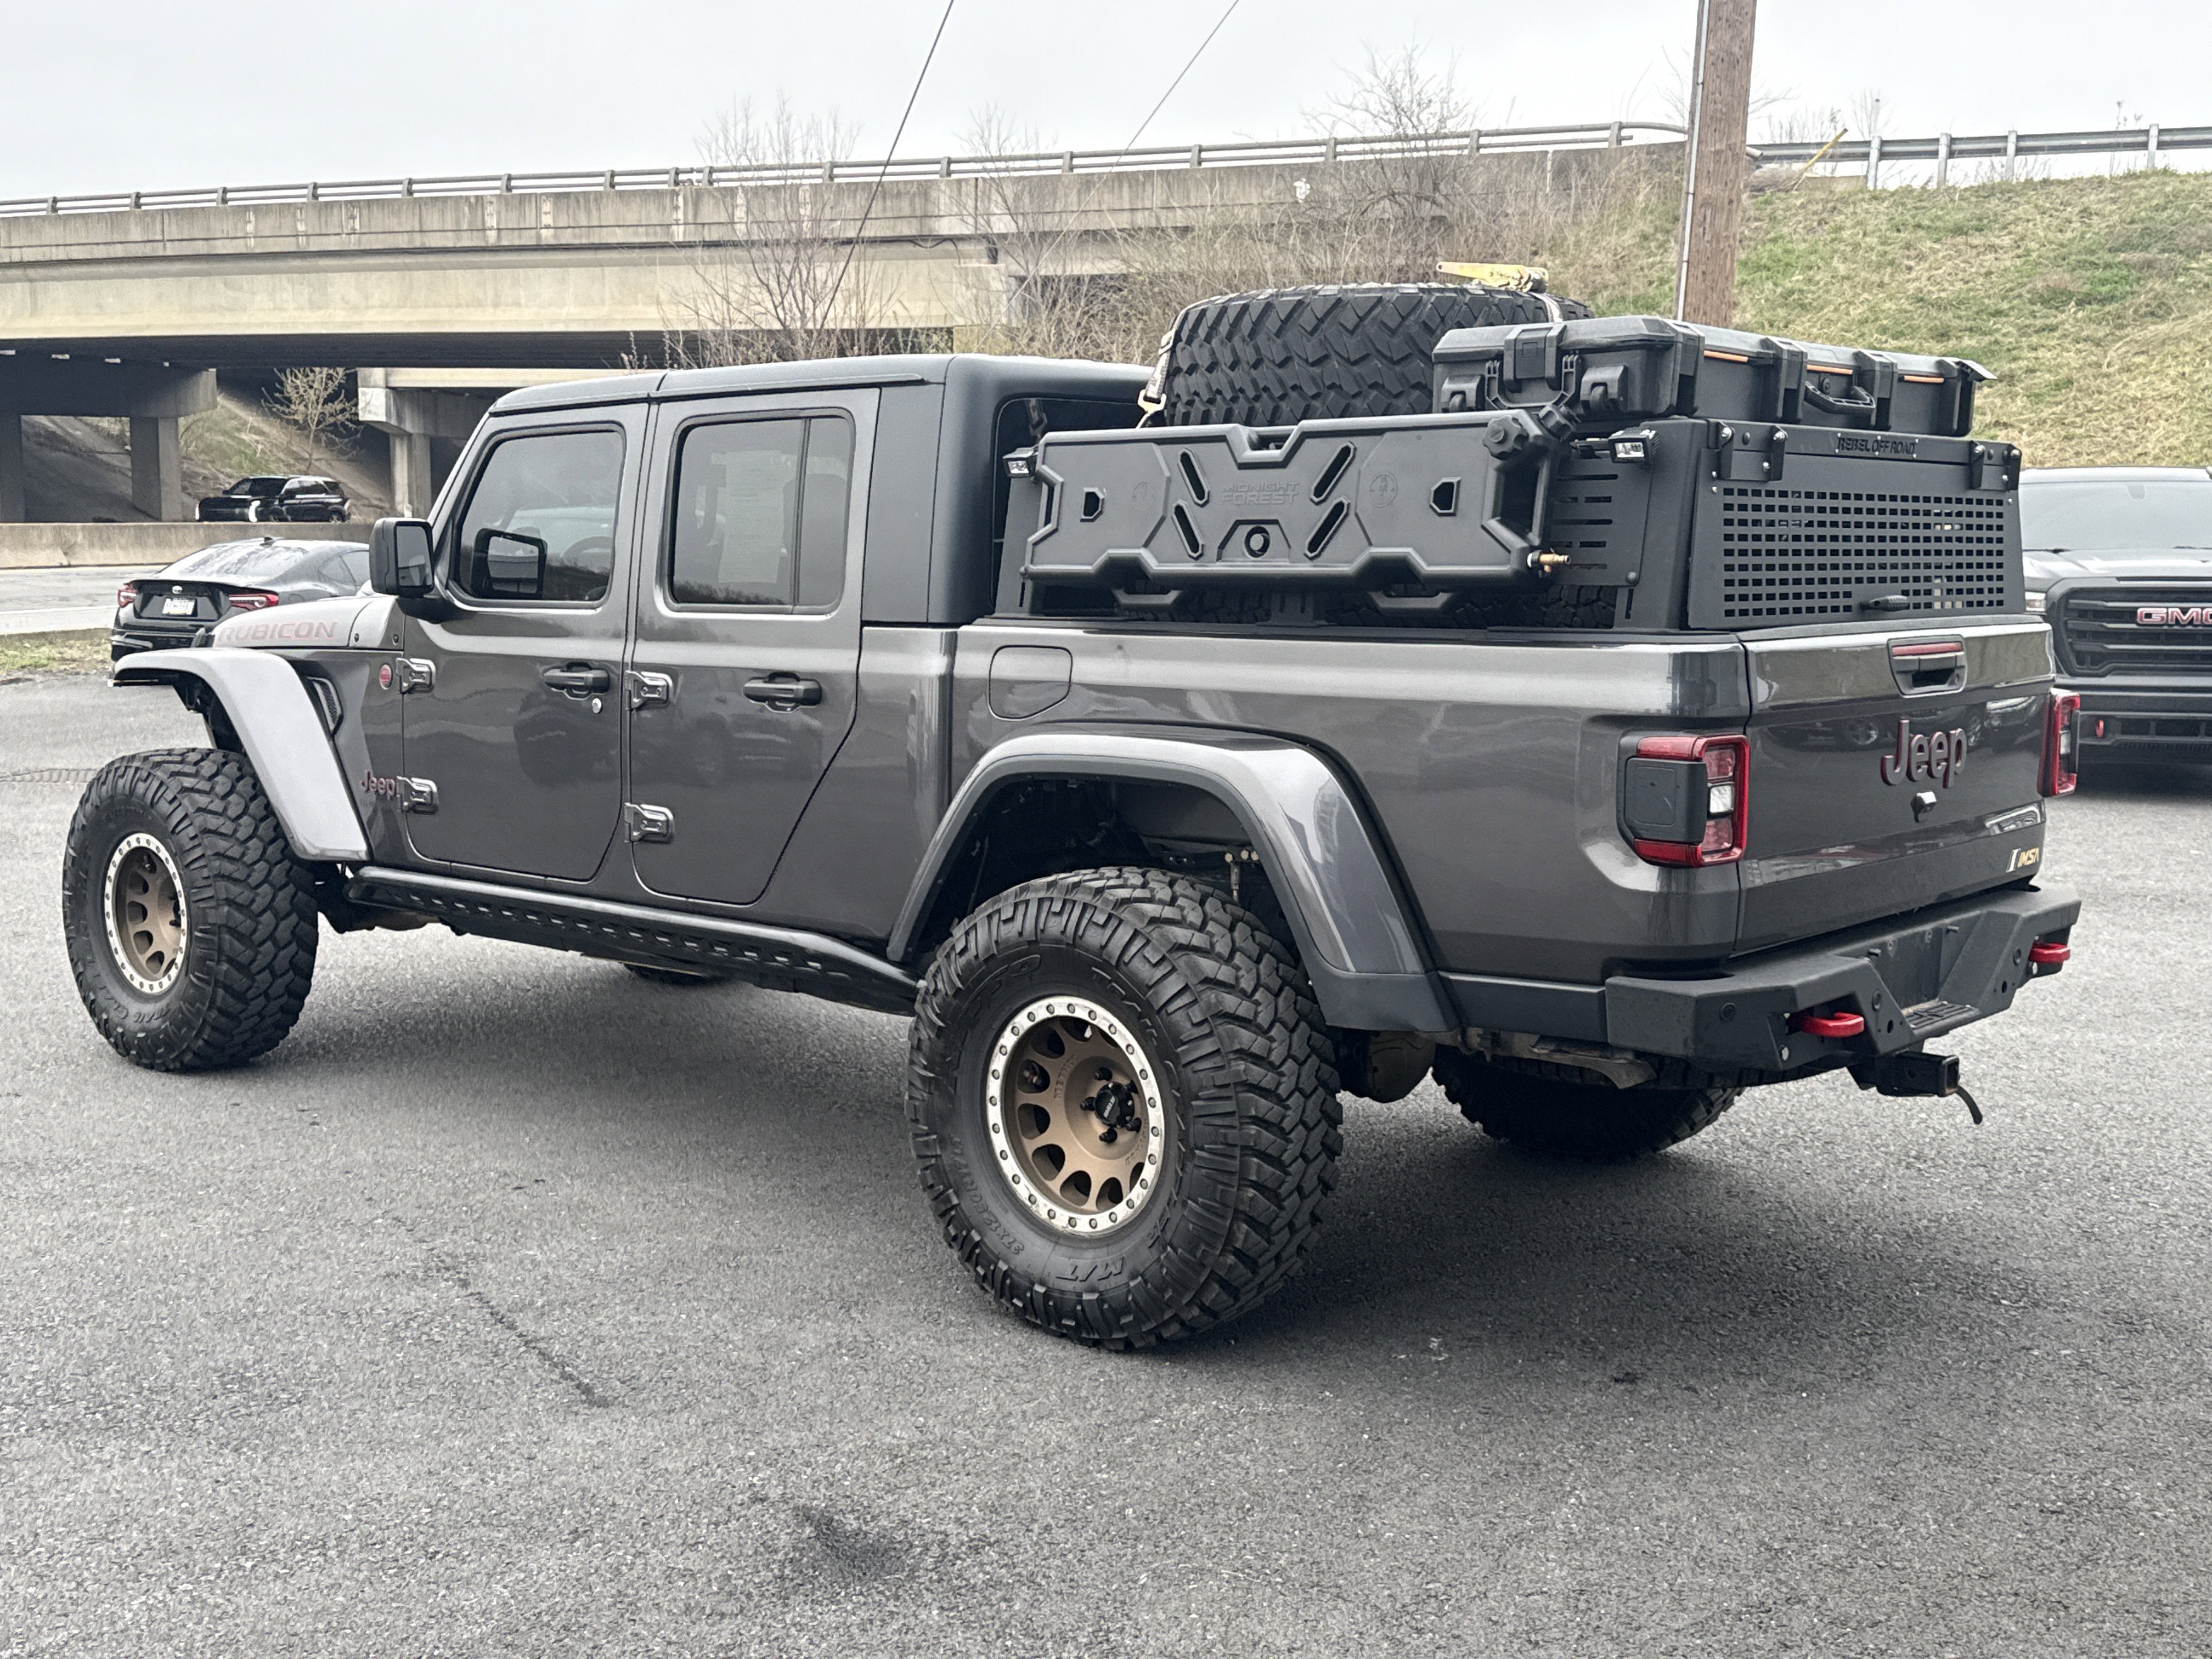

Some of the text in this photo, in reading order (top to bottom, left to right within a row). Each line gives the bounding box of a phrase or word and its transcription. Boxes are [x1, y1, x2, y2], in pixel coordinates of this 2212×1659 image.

[1838, 437, 1916, 455] REBEL OFF ROAD
[1223, 482, 1299, 492] MIDNIGHT
[1222, 492, 1299, 505] FOREST
[2137, 607, 2212, 627] GM
[218, 620, 338, 642] RUBICON
[1879, 719, 1968, 789] Jeep
[359, 769, 396, 799] Jeep
